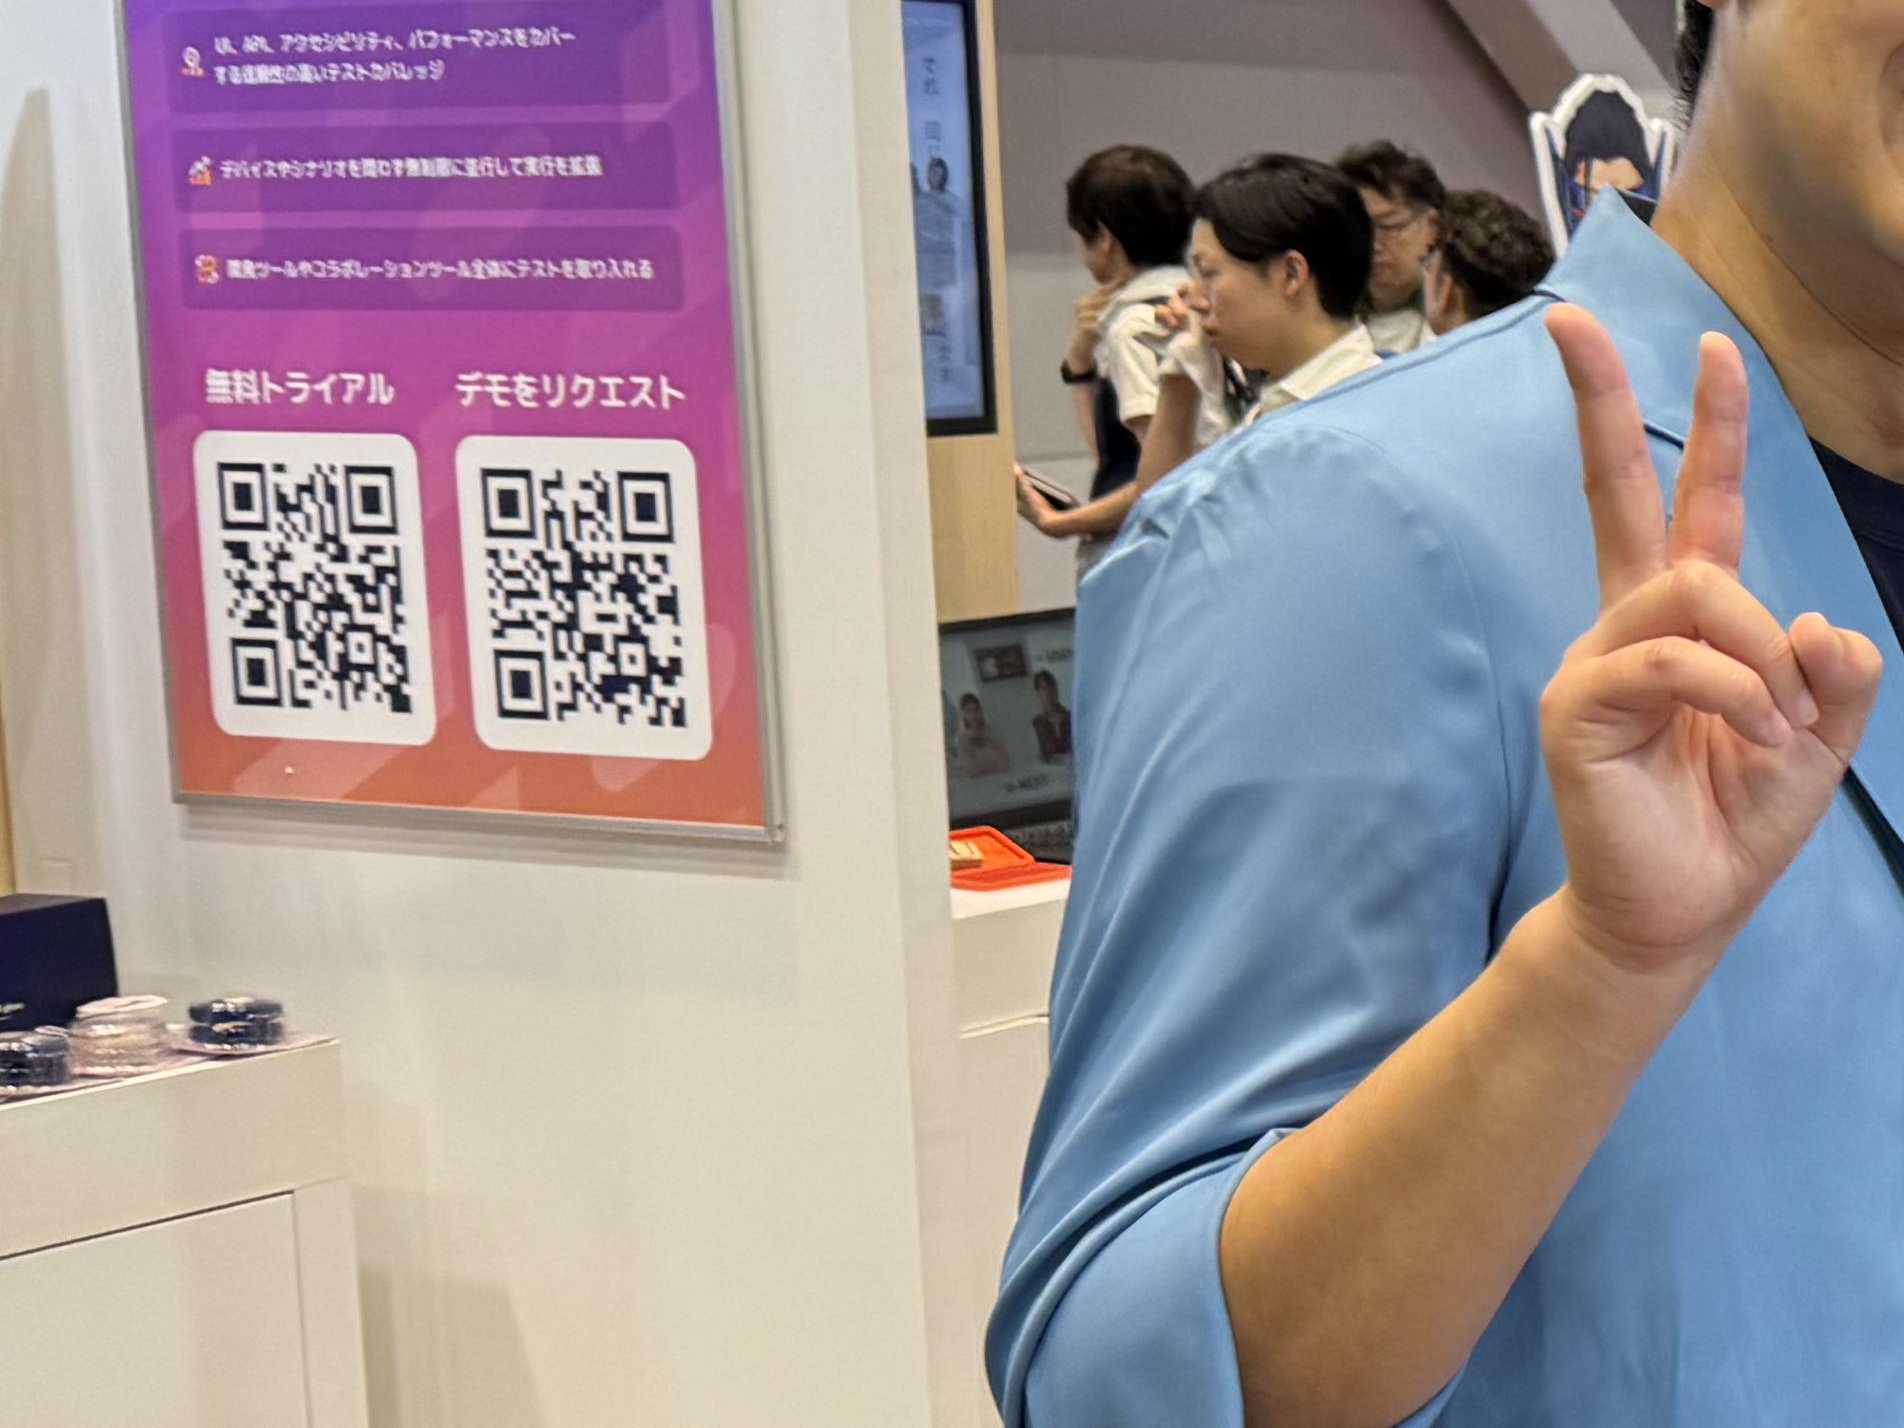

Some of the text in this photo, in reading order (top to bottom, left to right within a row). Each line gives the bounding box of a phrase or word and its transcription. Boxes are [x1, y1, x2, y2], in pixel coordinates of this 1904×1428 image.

[204, 368, 396, 407] 無料トライアル
[454, 369, 687, 411] デモをリクエスト
